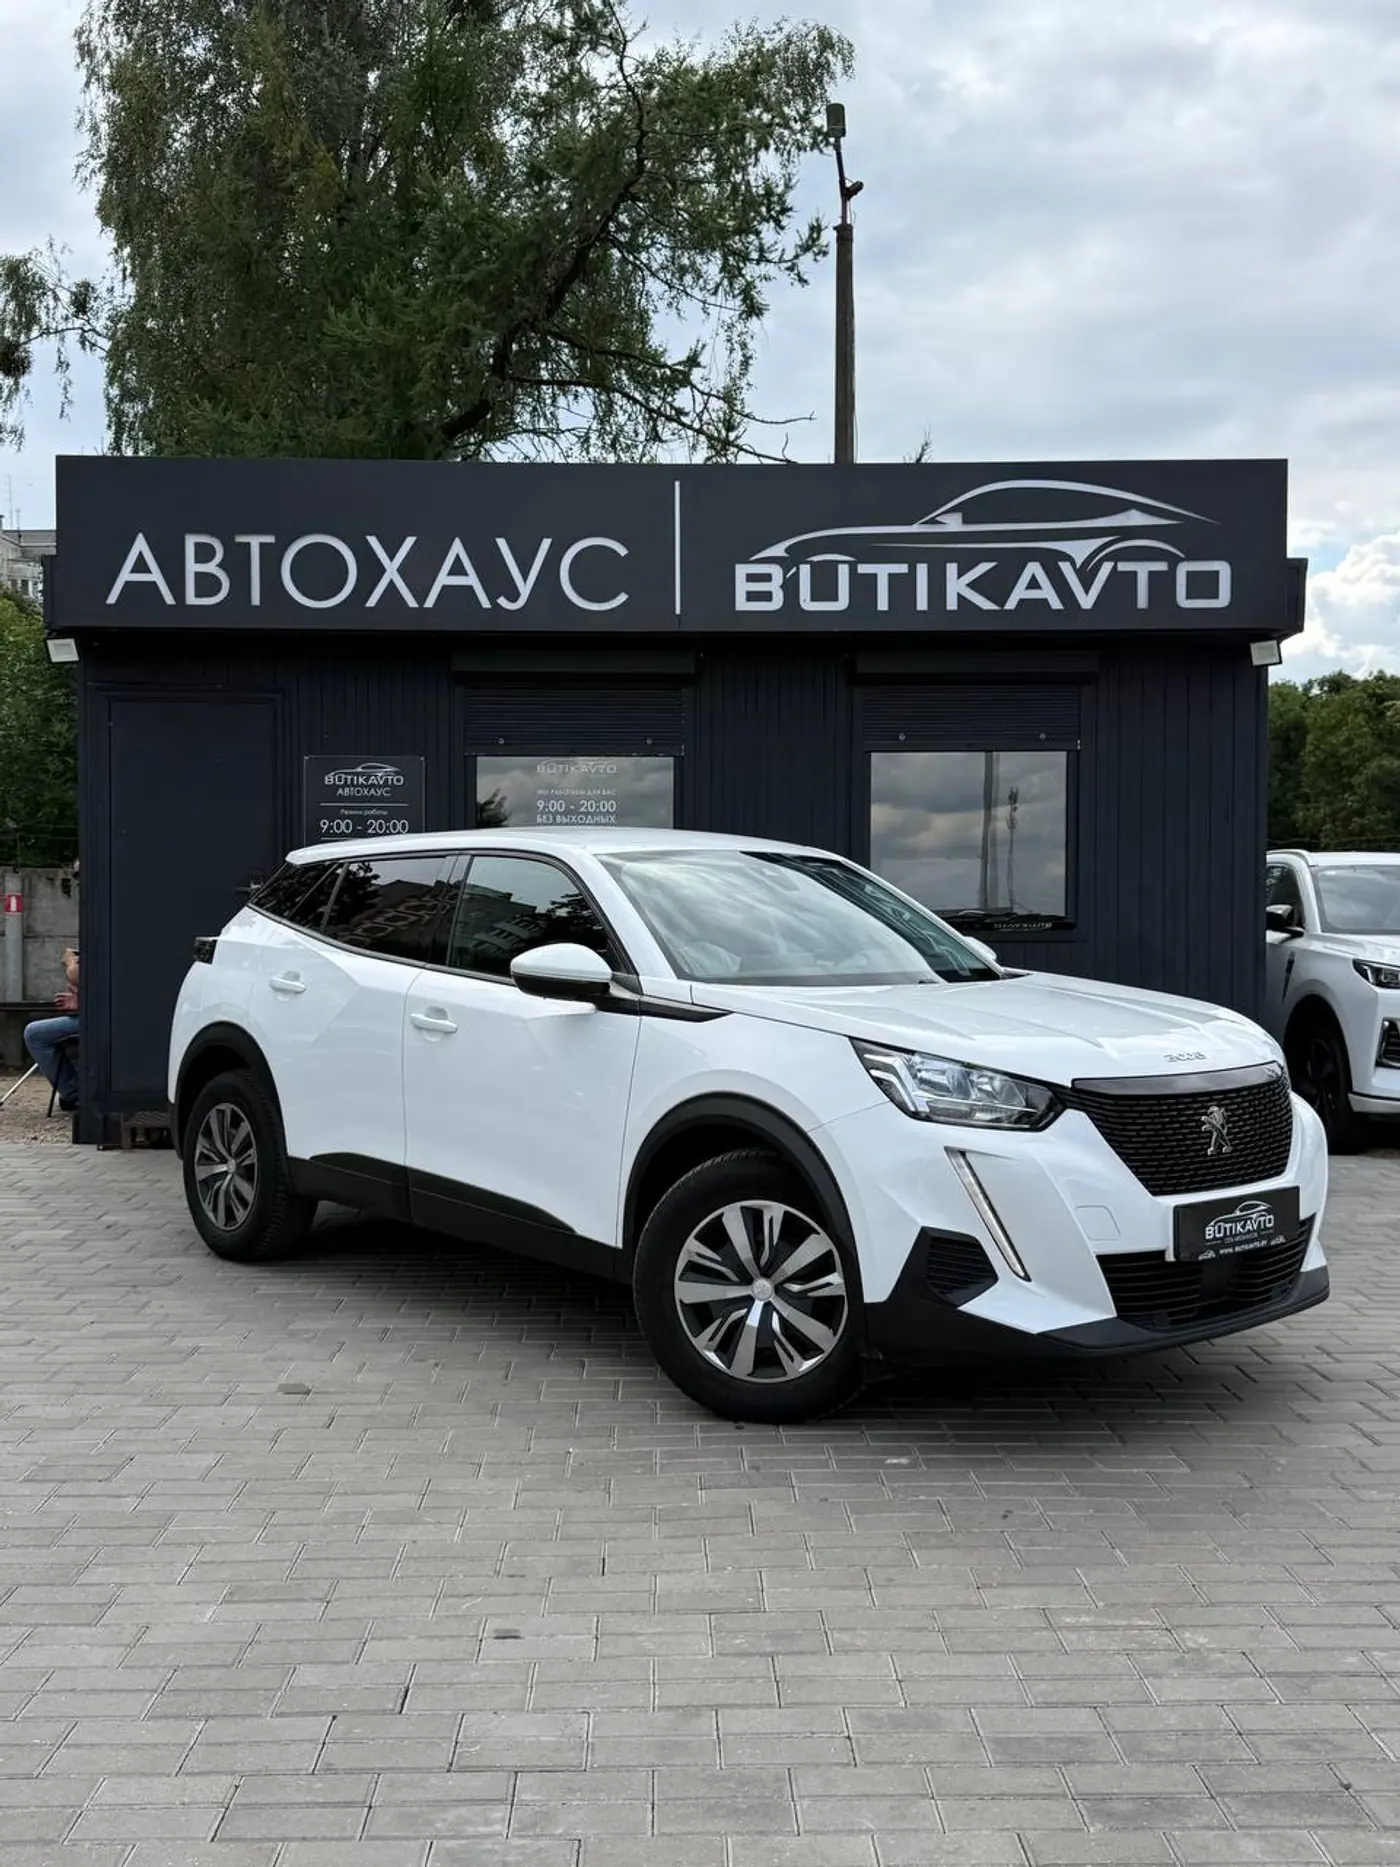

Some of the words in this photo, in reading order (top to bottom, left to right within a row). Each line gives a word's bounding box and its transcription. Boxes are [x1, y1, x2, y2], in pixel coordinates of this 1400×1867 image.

[105, 532, 630, 611] АВТОХАУС
[734, 559, 1232, 612] BUTIKAVTO
[536, 763, 618, 774] BUTIKAVTO
[324, 774, 404, 785] BUTIKAVTO
[336, 787, 392, 796] АВТОХАУС
[536, 800, 566, 812] 9:00
[579, 800, 617, 812] 20:00
[320, 819, 353, 834] 9:00
[366, 819, 410, 834] 20:00
[1205, 1215, 1274, 1239] BUTIKAVTO
